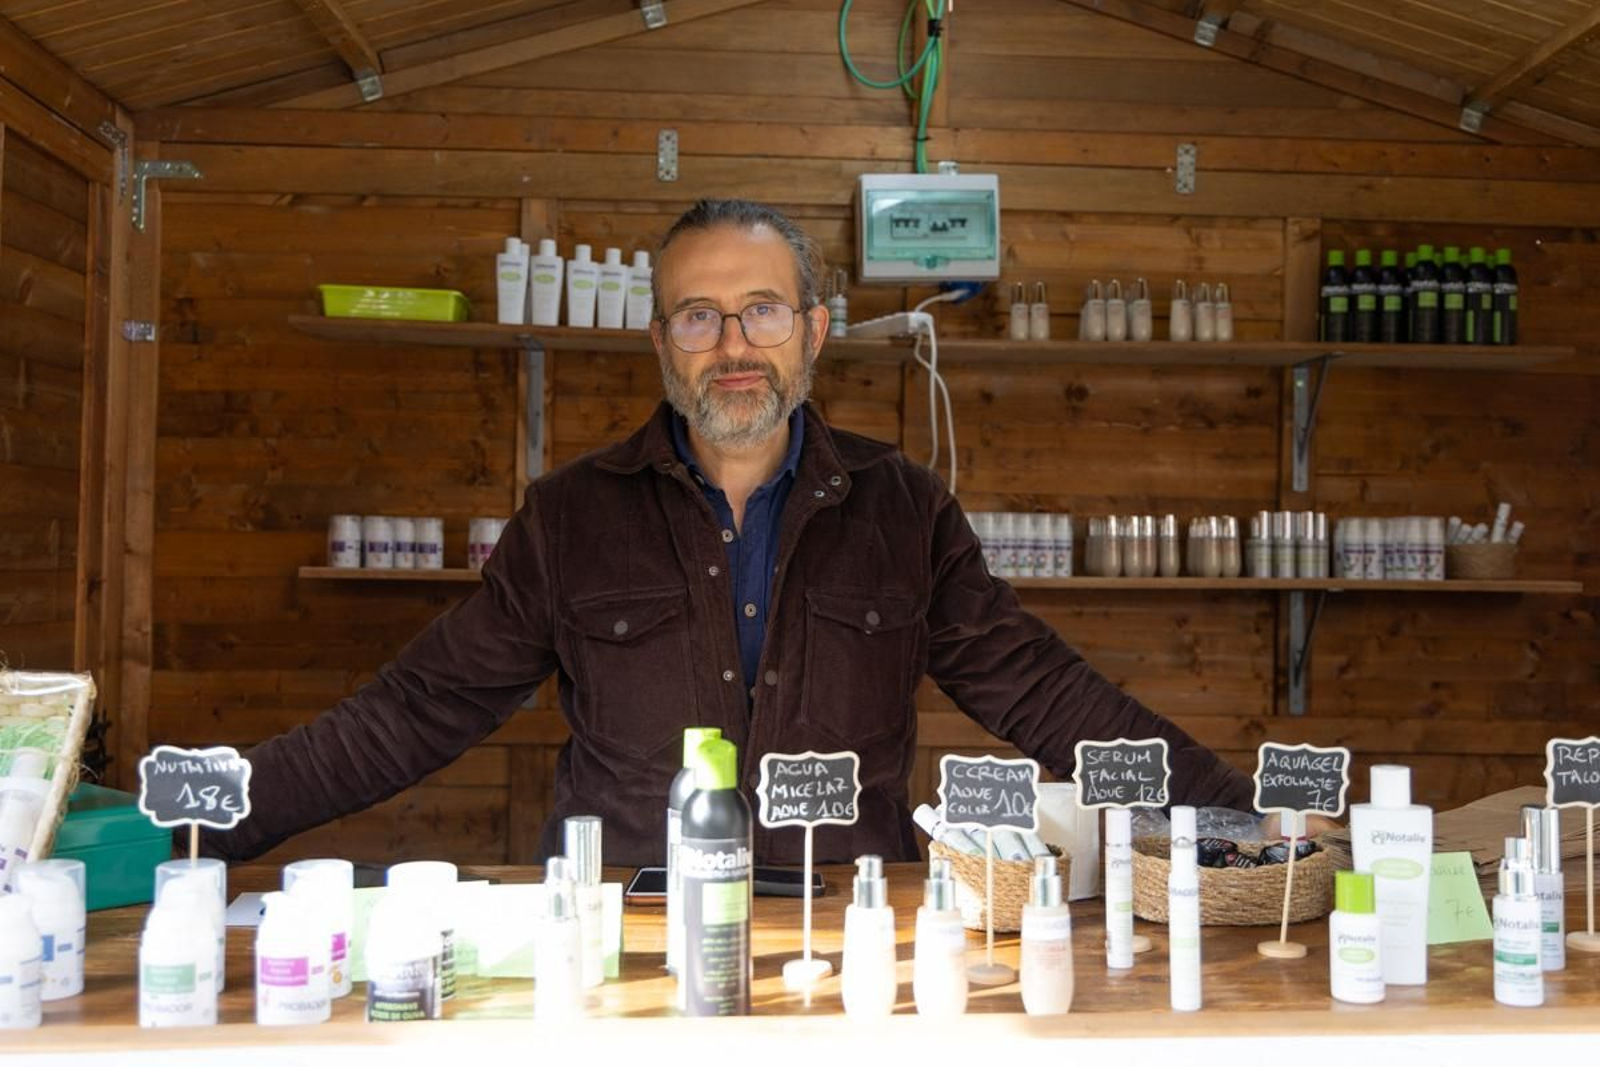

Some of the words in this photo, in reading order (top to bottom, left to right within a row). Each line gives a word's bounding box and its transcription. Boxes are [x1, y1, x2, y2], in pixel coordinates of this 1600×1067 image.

[1086, 749, 1151, 765] SERUM
[1266, 752, 1343, 773] AQUAGEL
[774, 762, 829, 778] AGUA
[1088, 768, 1155, 785] FACIAL
[771, 777, 849, 799] MICELAR
[1262, 773, 1337, 791] EXFOLIANTE
[176, 782, 241, 811] 18€
[948, 783, 993, 801] AOVE
[1086, 785, 1125, 803] AOVE
[1307, 789, 1337, 812] 7€
[770, 802, 809, 821] AOVE
